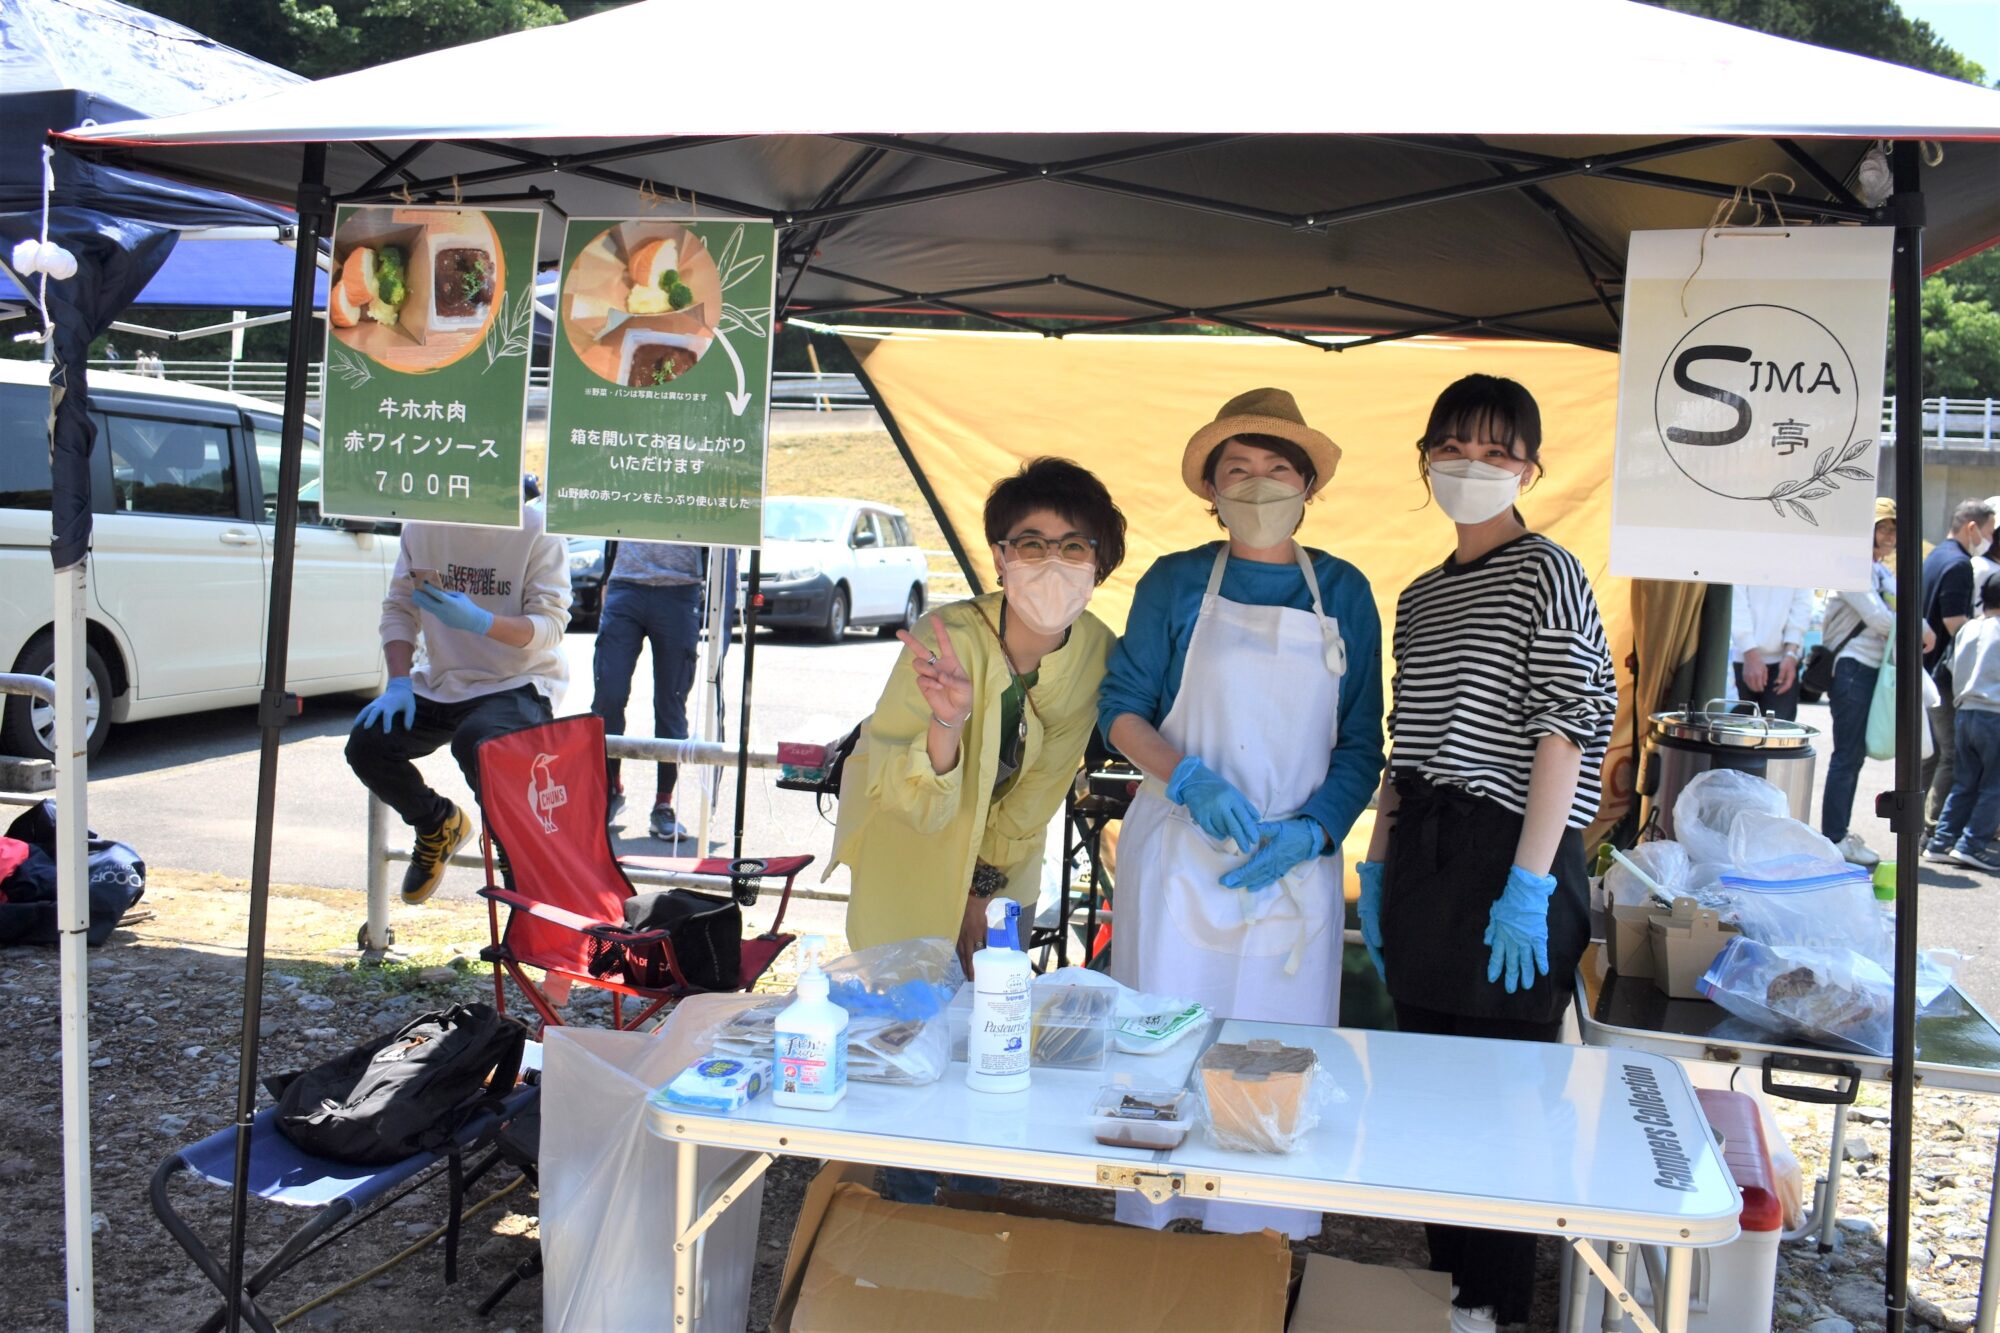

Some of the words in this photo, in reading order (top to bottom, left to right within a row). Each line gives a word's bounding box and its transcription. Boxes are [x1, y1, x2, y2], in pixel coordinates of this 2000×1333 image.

[1666, 344, 1841, 446] SIMA
[378, 396, 467, 423] 牛ホホ肉
[344, 430, 499, 459] 赤ワインソース
[570, 428, 746, 453] 箱を開いてお召し上がり
[1771, 417, 1812, 456] 亭
[610, 455, 705, 474] いただけます
[558, 487, 750, 509] 山野峡の赤ワインをたっぷり使いました
[447, 563, 497, 583] EVERYONE
[497, 580, 512, 597] US
[541, 787, 566, 808] CHUMS
[1621, 1064, 1674, 1128] Collection
[1644, 1126, 1698, 1193] Campers
